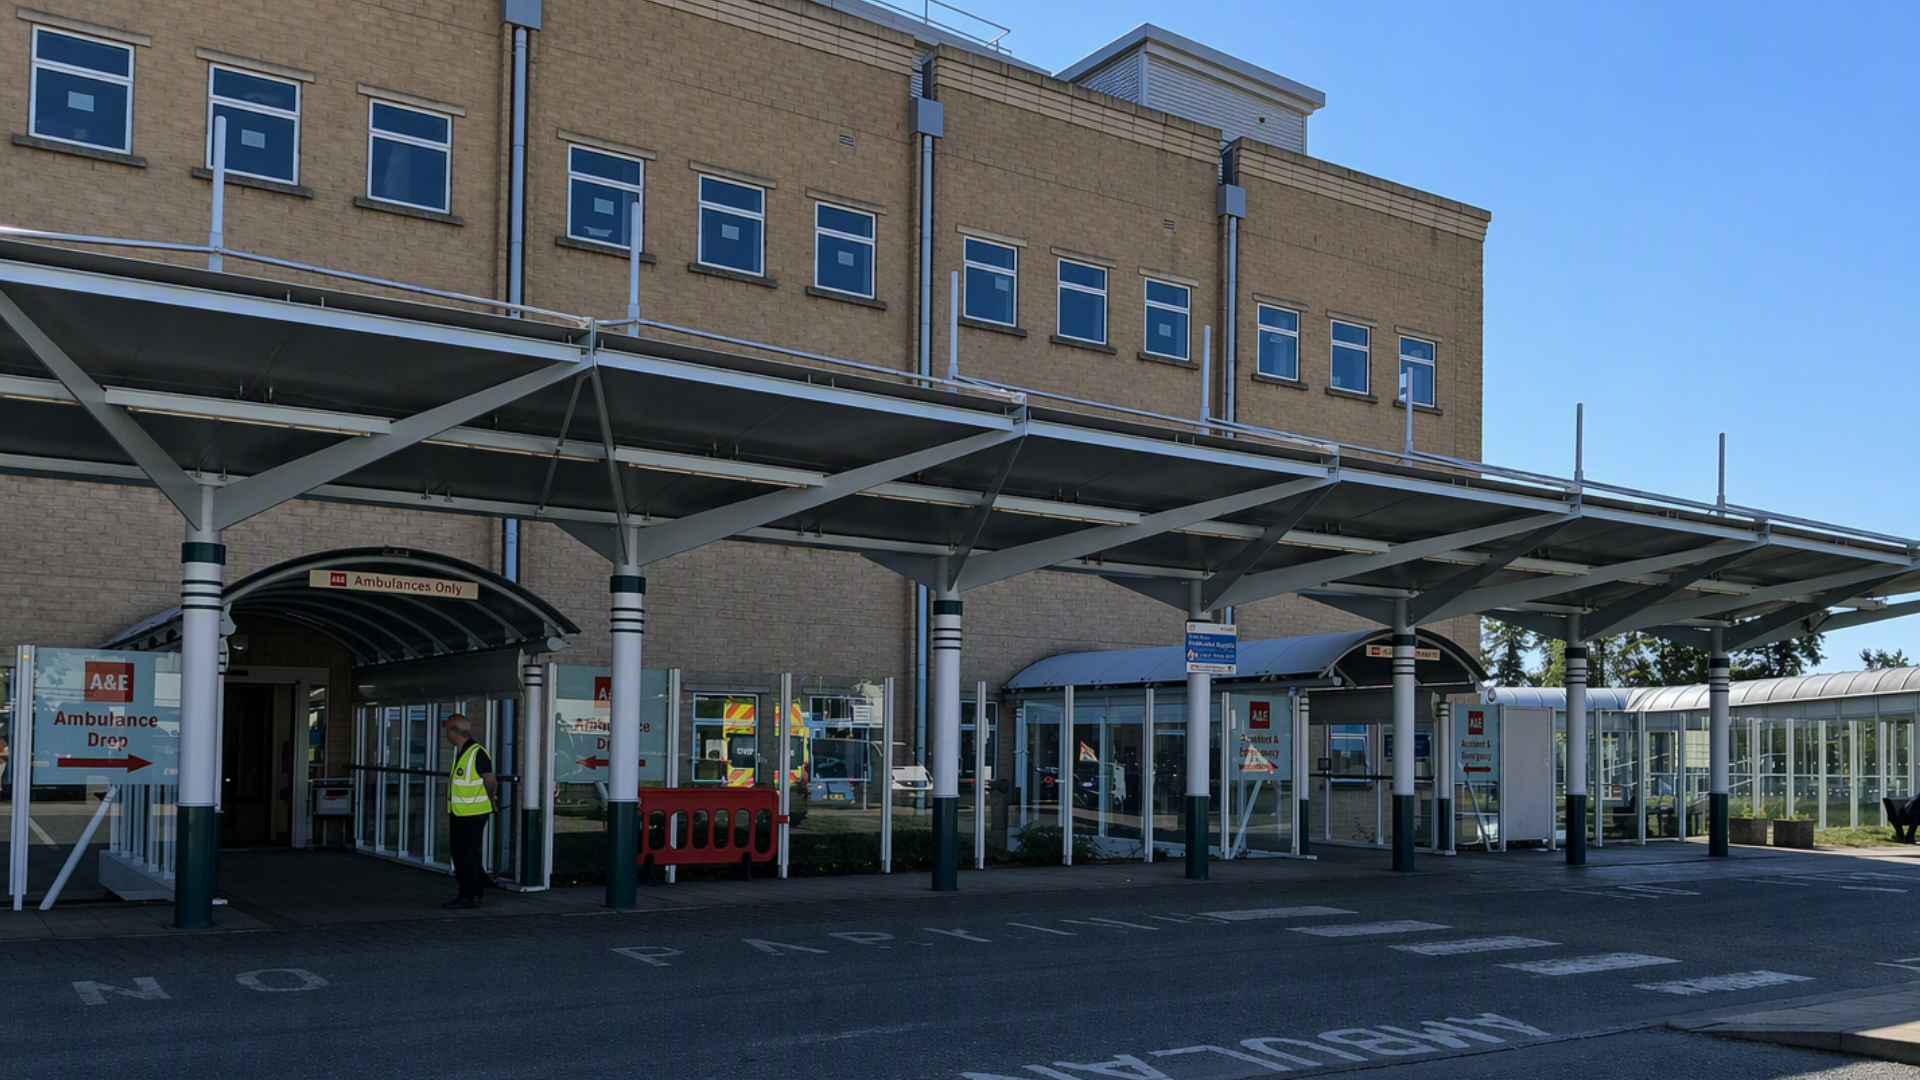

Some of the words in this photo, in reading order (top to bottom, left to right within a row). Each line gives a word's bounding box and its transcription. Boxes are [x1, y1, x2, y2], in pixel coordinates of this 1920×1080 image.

[354, 575, 431, 592] Ambulances
[435, 582, 463, 596] Only
[89, 673, 129, 691] A&E
[54, 711, 158, 727] Ambulance
[88, 732, 128, 751] Drop
[71, 968, 329, 1005] NO
